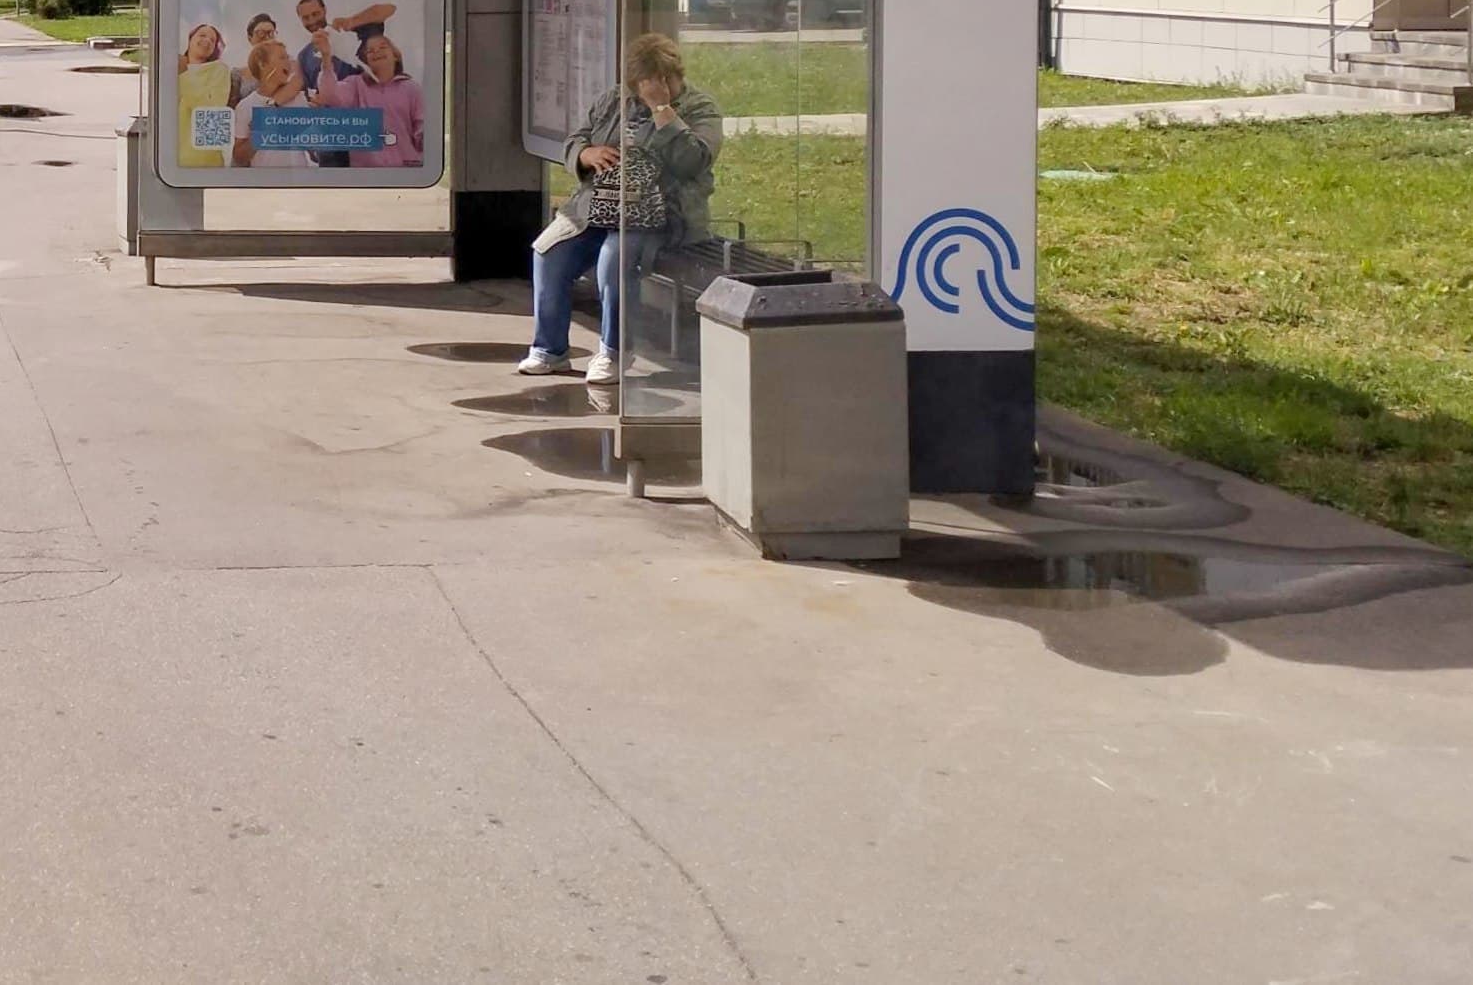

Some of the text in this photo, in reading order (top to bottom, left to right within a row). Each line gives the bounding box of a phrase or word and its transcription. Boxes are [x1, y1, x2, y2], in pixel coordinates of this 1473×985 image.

[264, 117, 369, 126] СТАНОВИТЕСЬ И ВЫ
[260, 132, 372, 147] усыновите.рф
